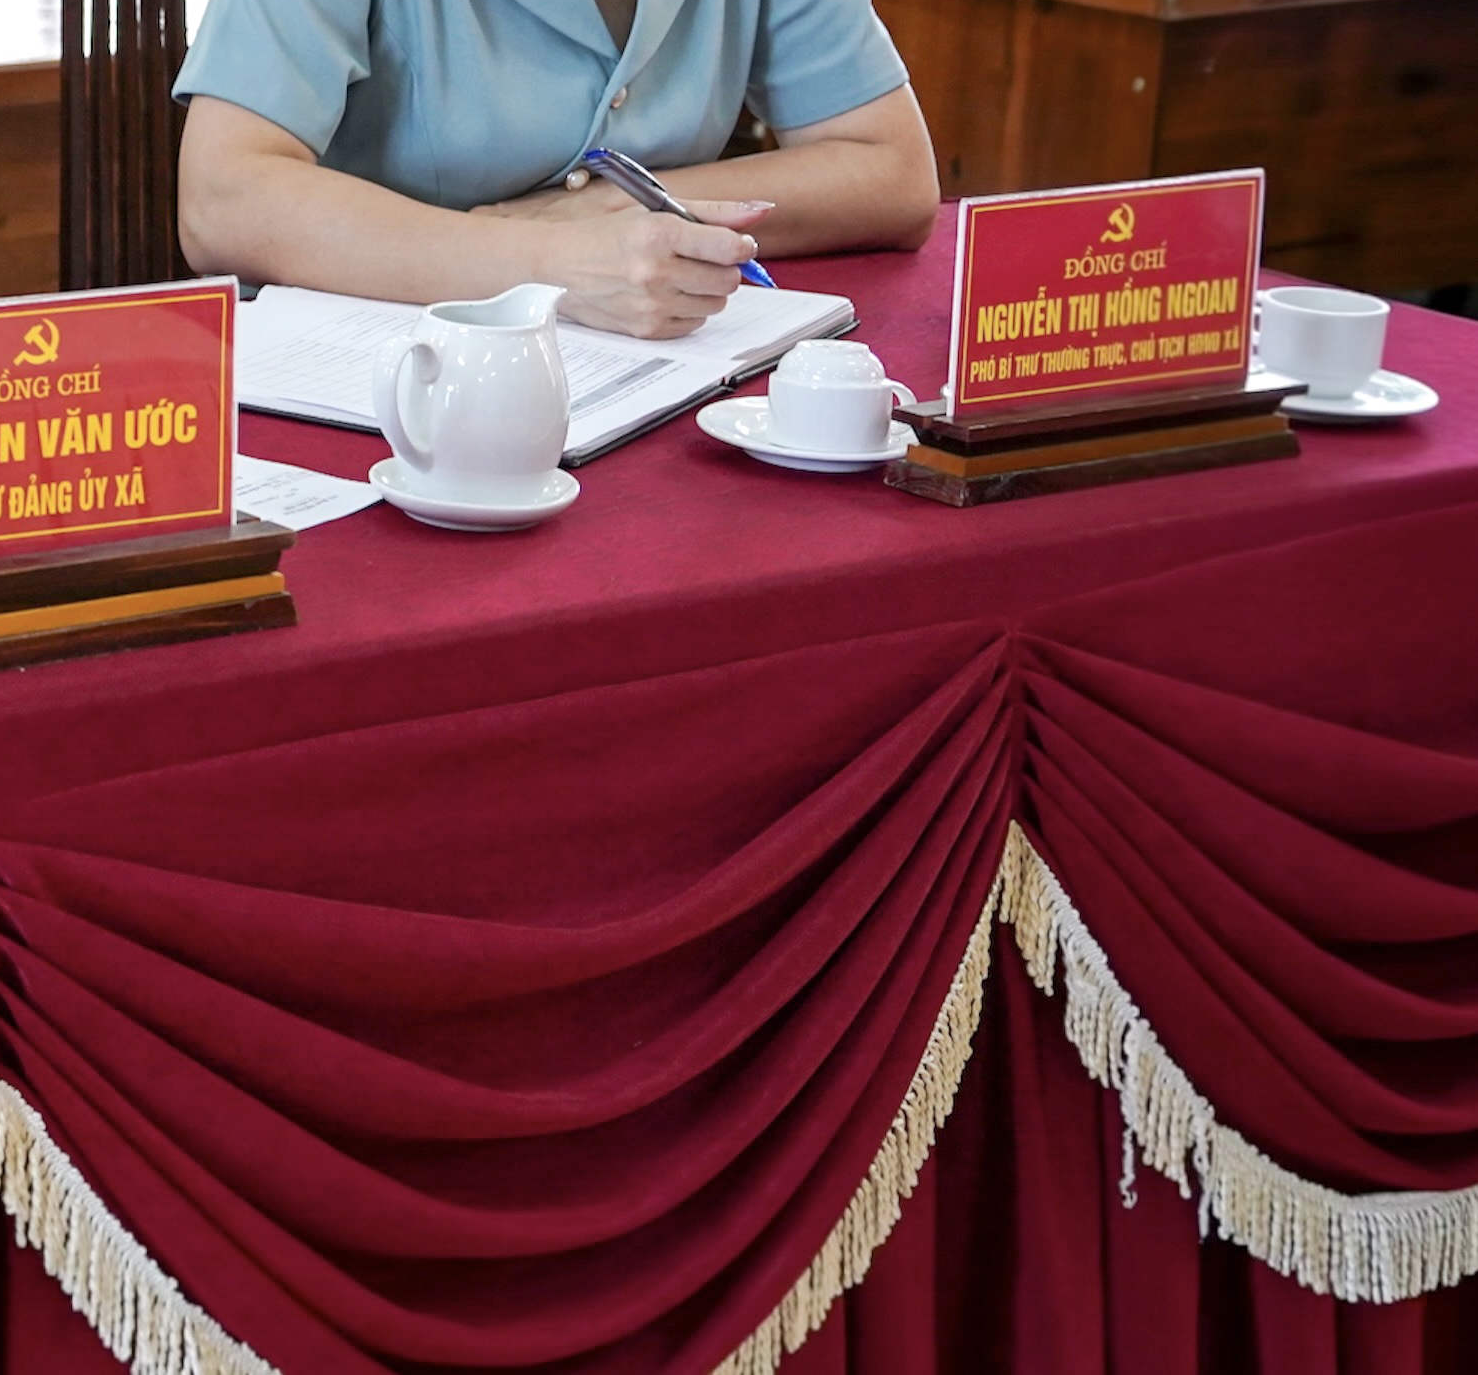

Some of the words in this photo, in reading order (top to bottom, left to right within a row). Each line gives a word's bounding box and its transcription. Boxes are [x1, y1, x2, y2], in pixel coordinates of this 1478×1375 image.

[1065, 247, 1124, 278] ĐỒNG
[1131, 242, 1166, 271] CHÍ
[978, 287, 1061, 342] NGUYỄN
[1069, 294, 1099, 336] THỊ
[1106, 278, 1160, 325] HỒNG
[1168, 278, 1237, 319] NGOAN
[58, 365, 100, 395] CHÍ
[971, 354, 995, 382] PHÓ
[1000, 351, 1012, 379] BÍ
[1016, 351, 1041, 374] THƯ
[1043, 344, 1089, 373] THƯỜNG
[1131, 333, 1154, 361] CHỦ
[1159, 336, 1184, 362] TỊCH
[38, 407, 112, 458] VĂN
[125, 398, 197, 449] ƯỚC
[10, 472, 72, 518] ĐẢNG
[79, 467, 107, 510] ỦY
[115, 466, 144, 505] XÃ
